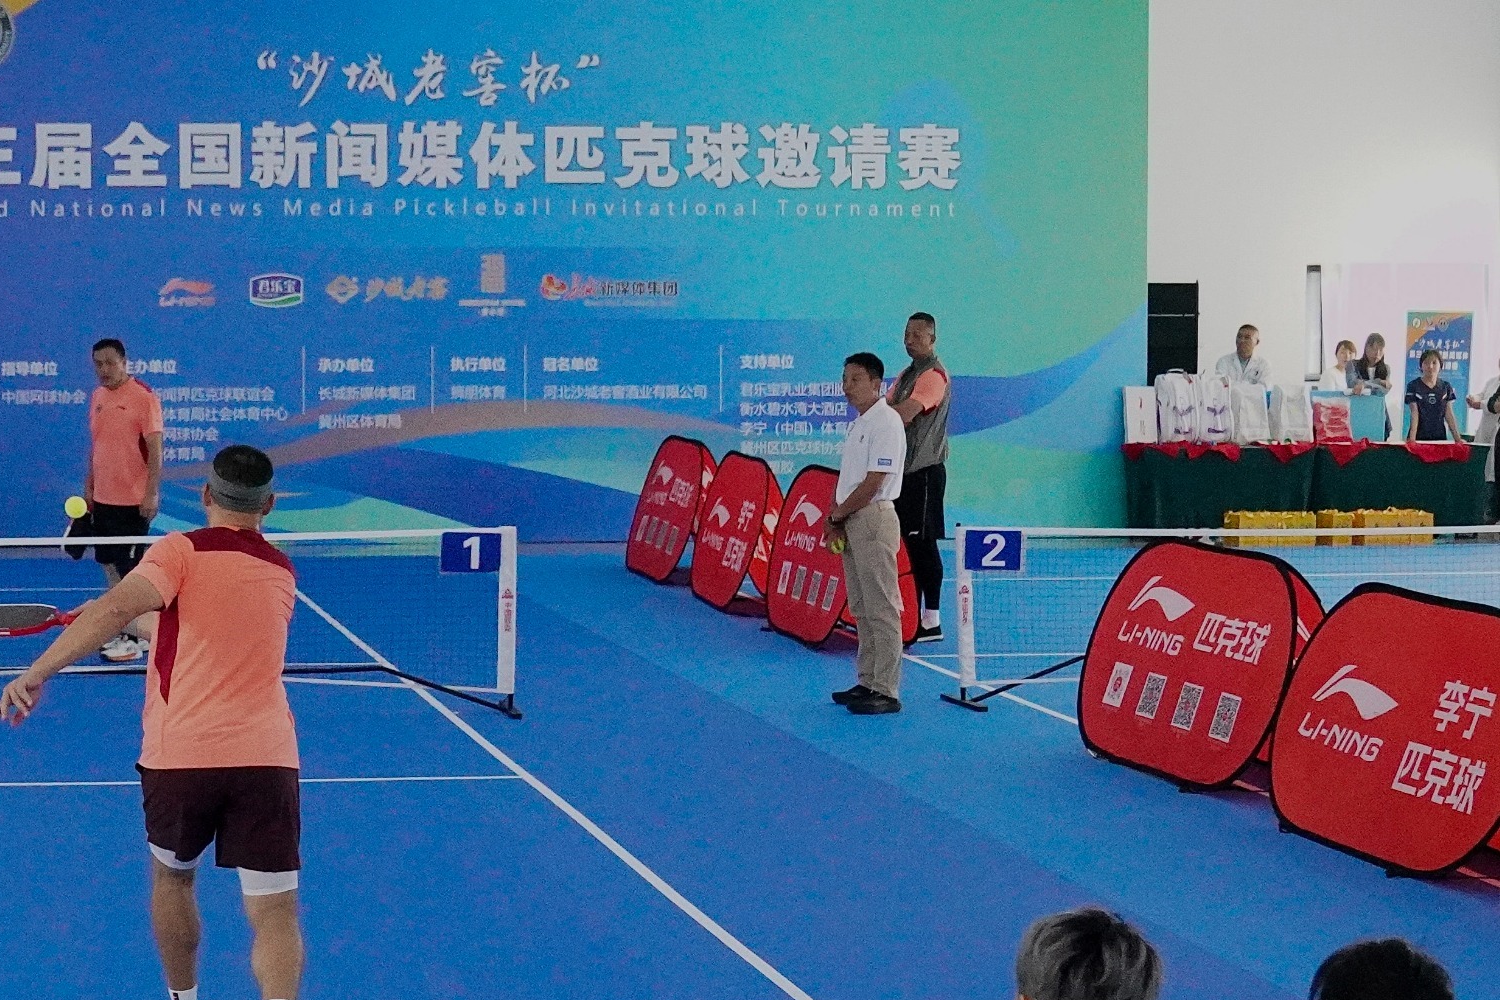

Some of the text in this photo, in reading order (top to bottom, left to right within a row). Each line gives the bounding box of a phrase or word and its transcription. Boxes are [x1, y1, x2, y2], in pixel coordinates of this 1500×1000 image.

[31, 199, 167, 218] National
[187, 199, 263, 218] News
[284, 198, 374, 217] Media
[395, 198, 551, 217] Pickleball
[572, 198, 757, 217] Invitational
[778, 199, 956, 218] Tournament
[318, 357, 374, 373] 承办单位
[450, 356, 506, 372] 执行单位
[543, 356, 599, 373] 冠名单位
[740, 354, 794, 370] 支持单位
[463, 536, 481, 570] 1
[981, 533, 1006, 567] 2
[1117, 620, 1185, 656] LI-NING
[1193, 612, 1271, 665] 匹克球
[1433, 680, 1497, 740] 李宁
[1297, 711, 1384, 762] LI-NING
[1391, 741, 1486, 815] 匹克球
